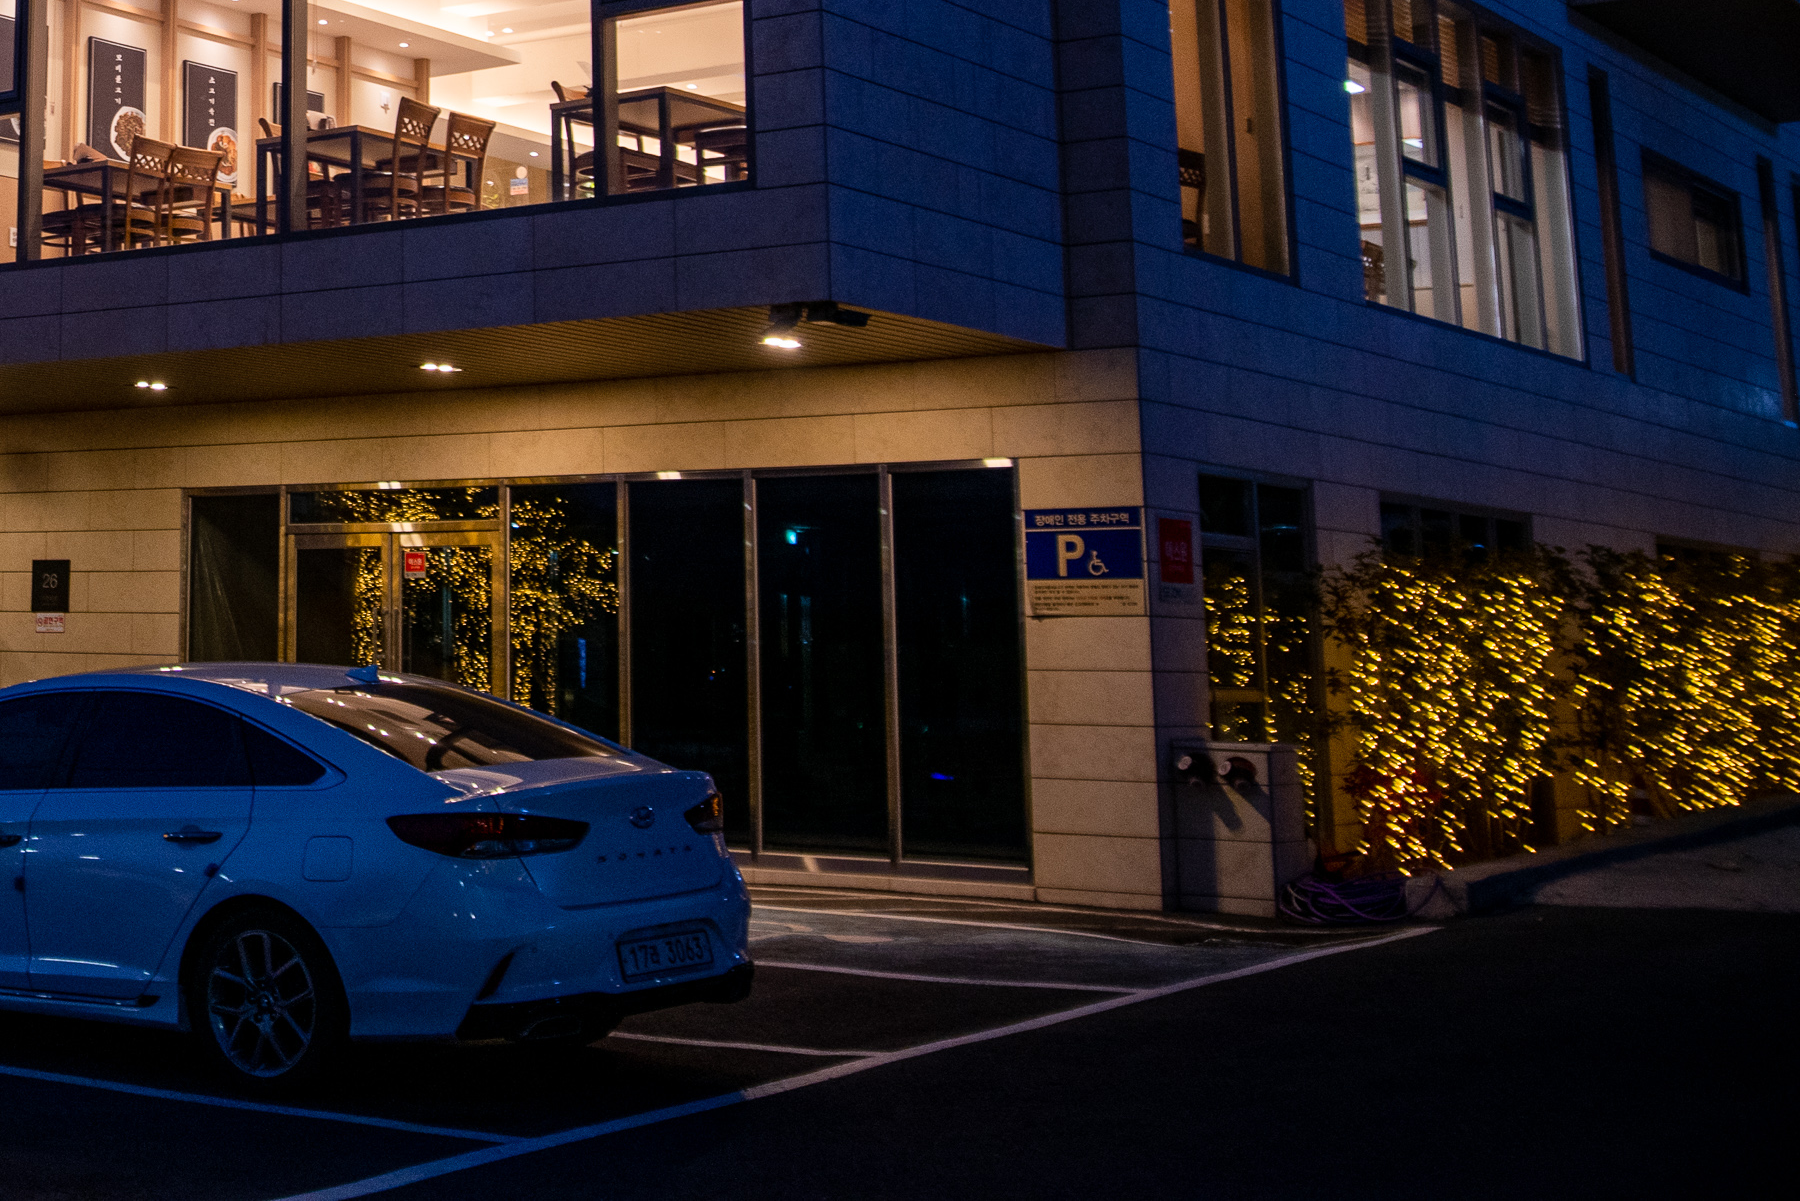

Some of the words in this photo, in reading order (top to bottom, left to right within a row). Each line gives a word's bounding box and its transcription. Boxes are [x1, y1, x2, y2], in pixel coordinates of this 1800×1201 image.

[1034, 515, 1064, 526] 장애인
[1067, 513, 1087, 526] 전용
[1090, 512, 1130, 524] 주차구역
[1056, 534, 1085, 577] P
[42, 572, 58, 589] 26
